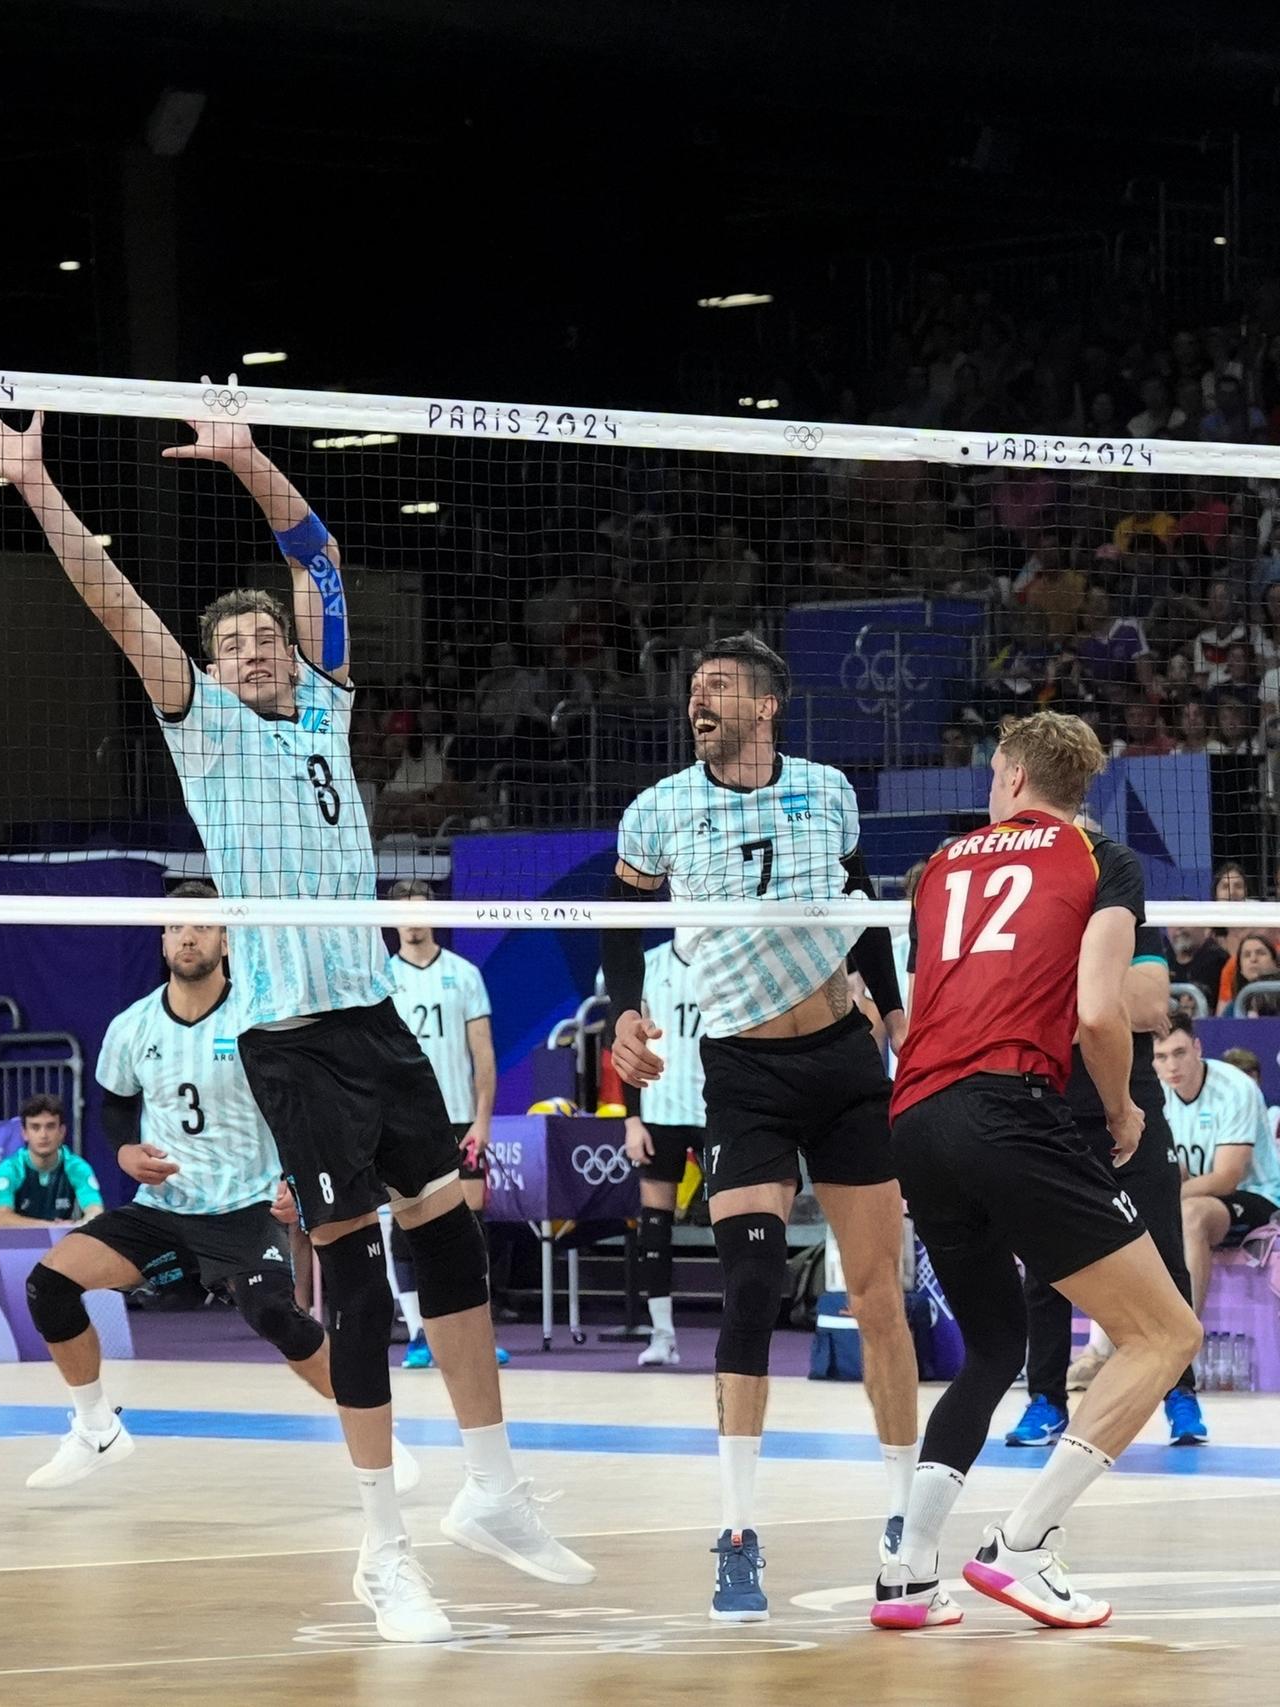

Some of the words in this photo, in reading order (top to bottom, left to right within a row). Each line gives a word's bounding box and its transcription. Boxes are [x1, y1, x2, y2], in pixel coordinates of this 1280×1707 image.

[536, 411, 617, 439] 2024
[1079, 442, 1151, 466] 2024
[308, 554, 344, 619] ARG
[307, 753, 340, 825] 8
[787, 811, 812, 823] ARG
[948, 826, 1061, 861] BREHME
[741, 839, 774, 896] 7
[541, 907, 592, 921] 2024
[941, 864, 1033, 961] 12
[412, 1003, 443, 1039] 21
[675, 1003, 701, 1038] 17
[213, 1054, 235, 1062] ARG
[178, 1082, 204, 1135] 3
[711, 1144, 721, 1174] 7
[319, 1172, 334, 1204] 8
[486, 1168, 525, 1190] 024
[1112, 1190, 1138, 1223] 12
